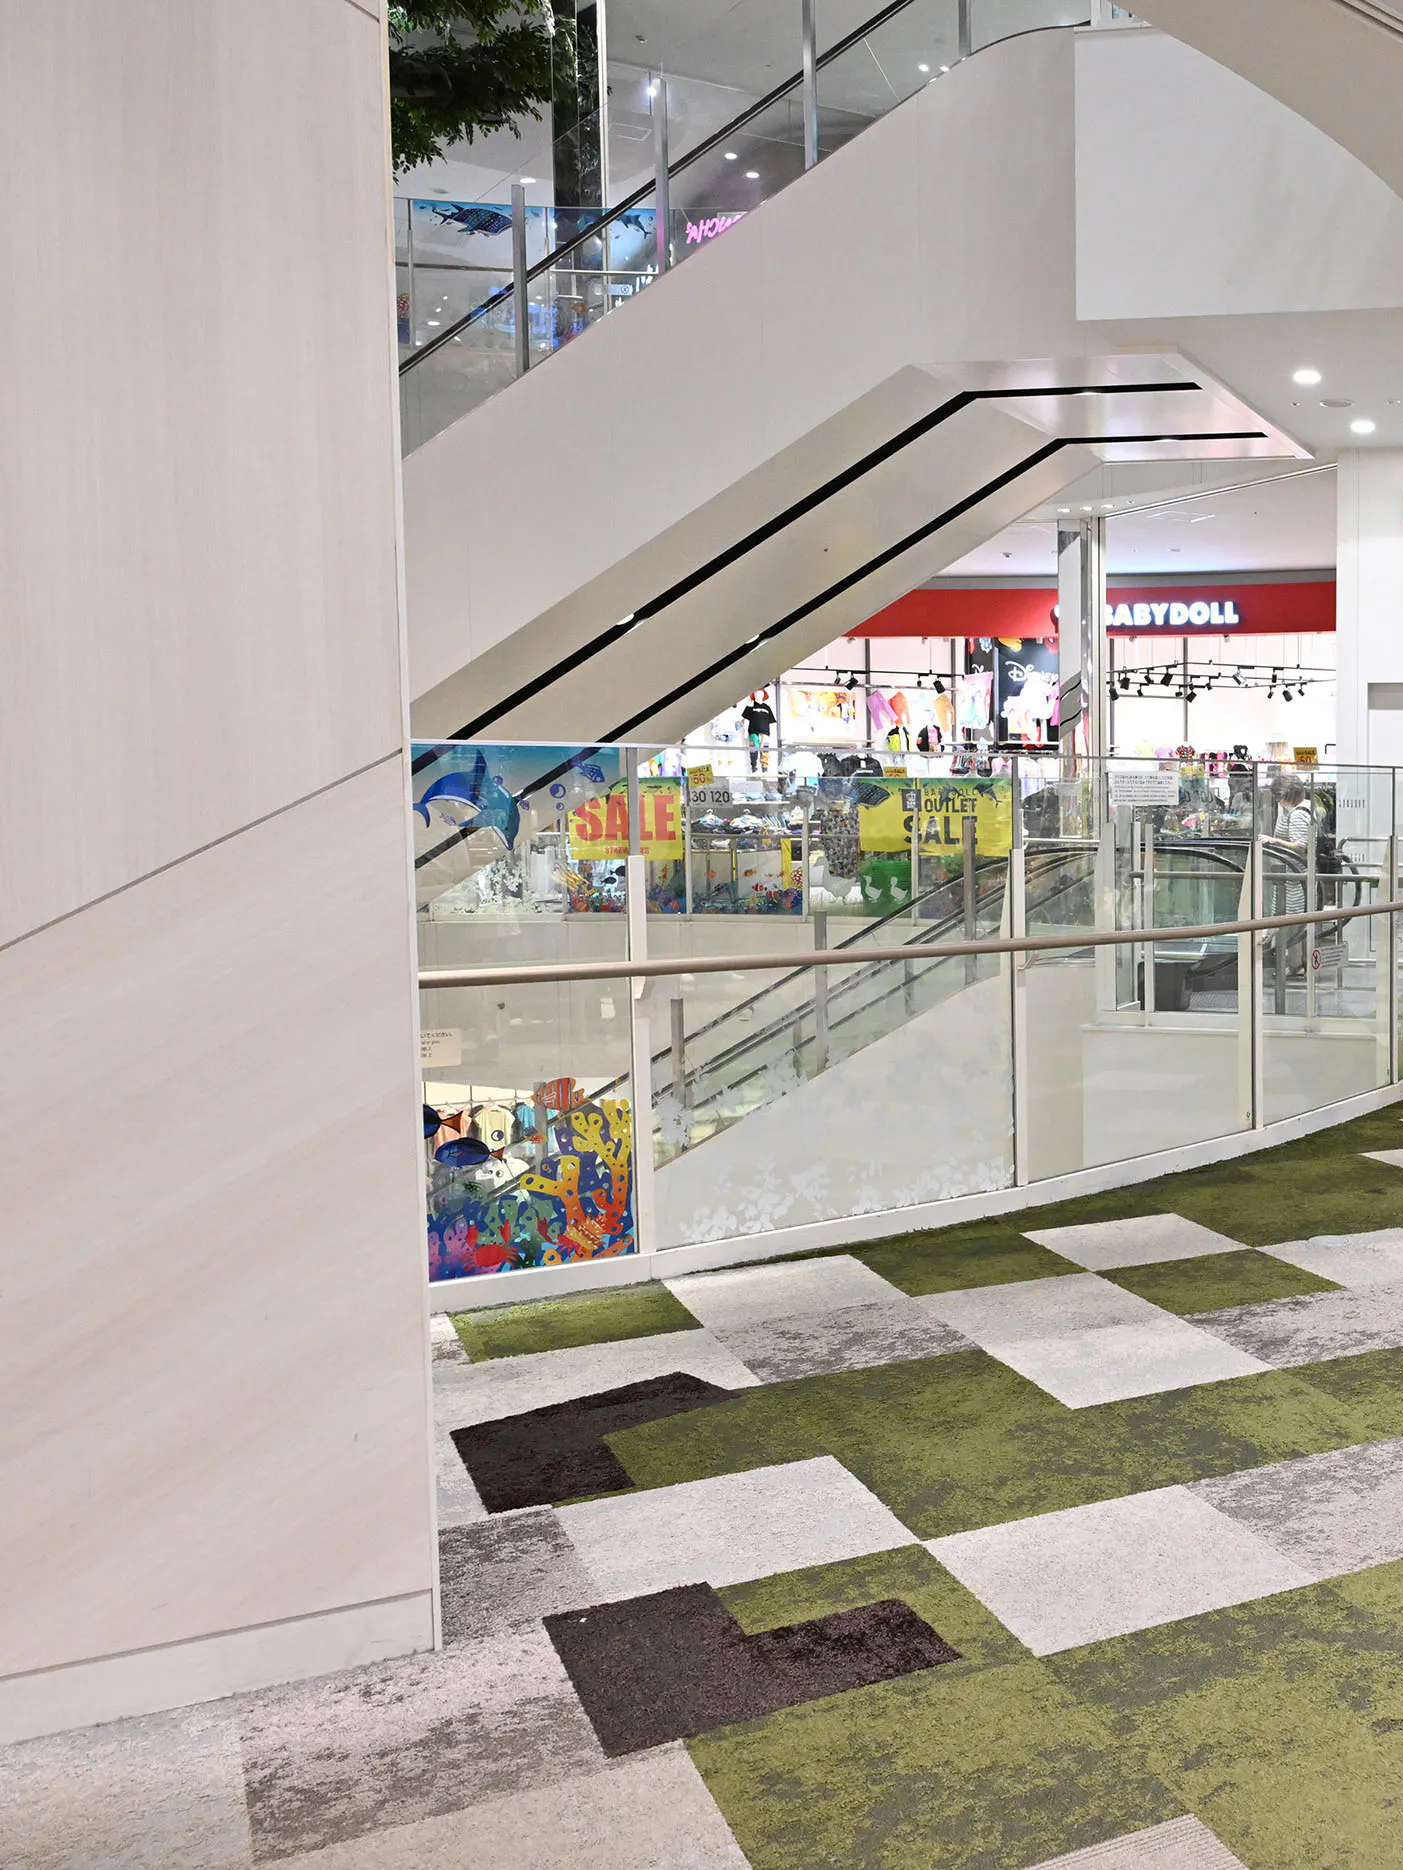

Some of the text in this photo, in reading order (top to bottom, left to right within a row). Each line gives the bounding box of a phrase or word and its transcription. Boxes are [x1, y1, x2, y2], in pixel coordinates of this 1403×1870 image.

[688, 790, 730, 803] 30 120
[924, 798, 977, 813] OUTLET
[575, 794, 676, 842] SALE
